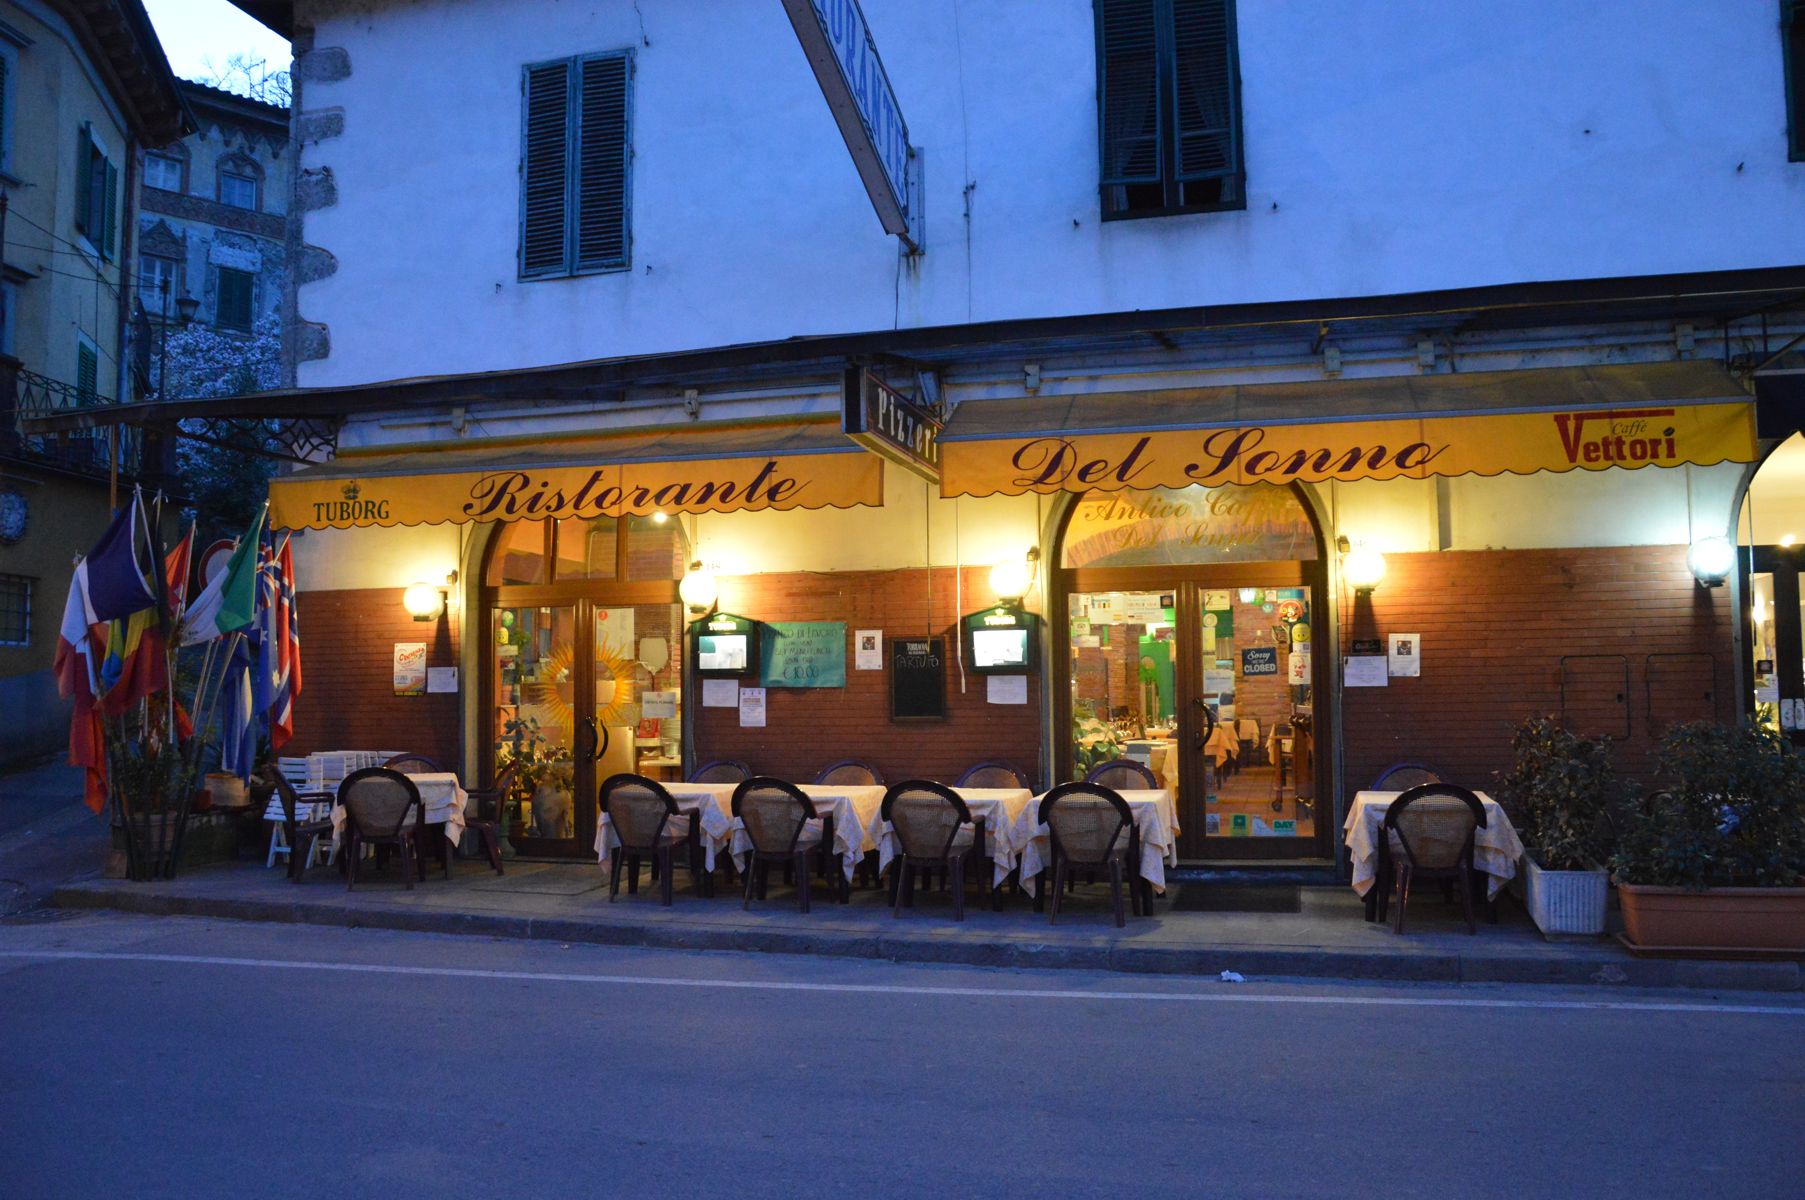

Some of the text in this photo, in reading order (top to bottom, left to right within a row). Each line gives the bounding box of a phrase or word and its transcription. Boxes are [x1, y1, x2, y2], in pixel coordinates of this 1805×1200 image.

[820, 0, 904, 200] ORANTE
[1012, 428, 1451, 487] Del Sonno
[1553, 409, 1676, 463] Vettori
[313, 500, 390, 522] TUBORG
[463, 461, 813, 516] Ristorante
[1085, 492, 1188, 521] Antico
[1244, 663, 1276, 672] CLOSED
